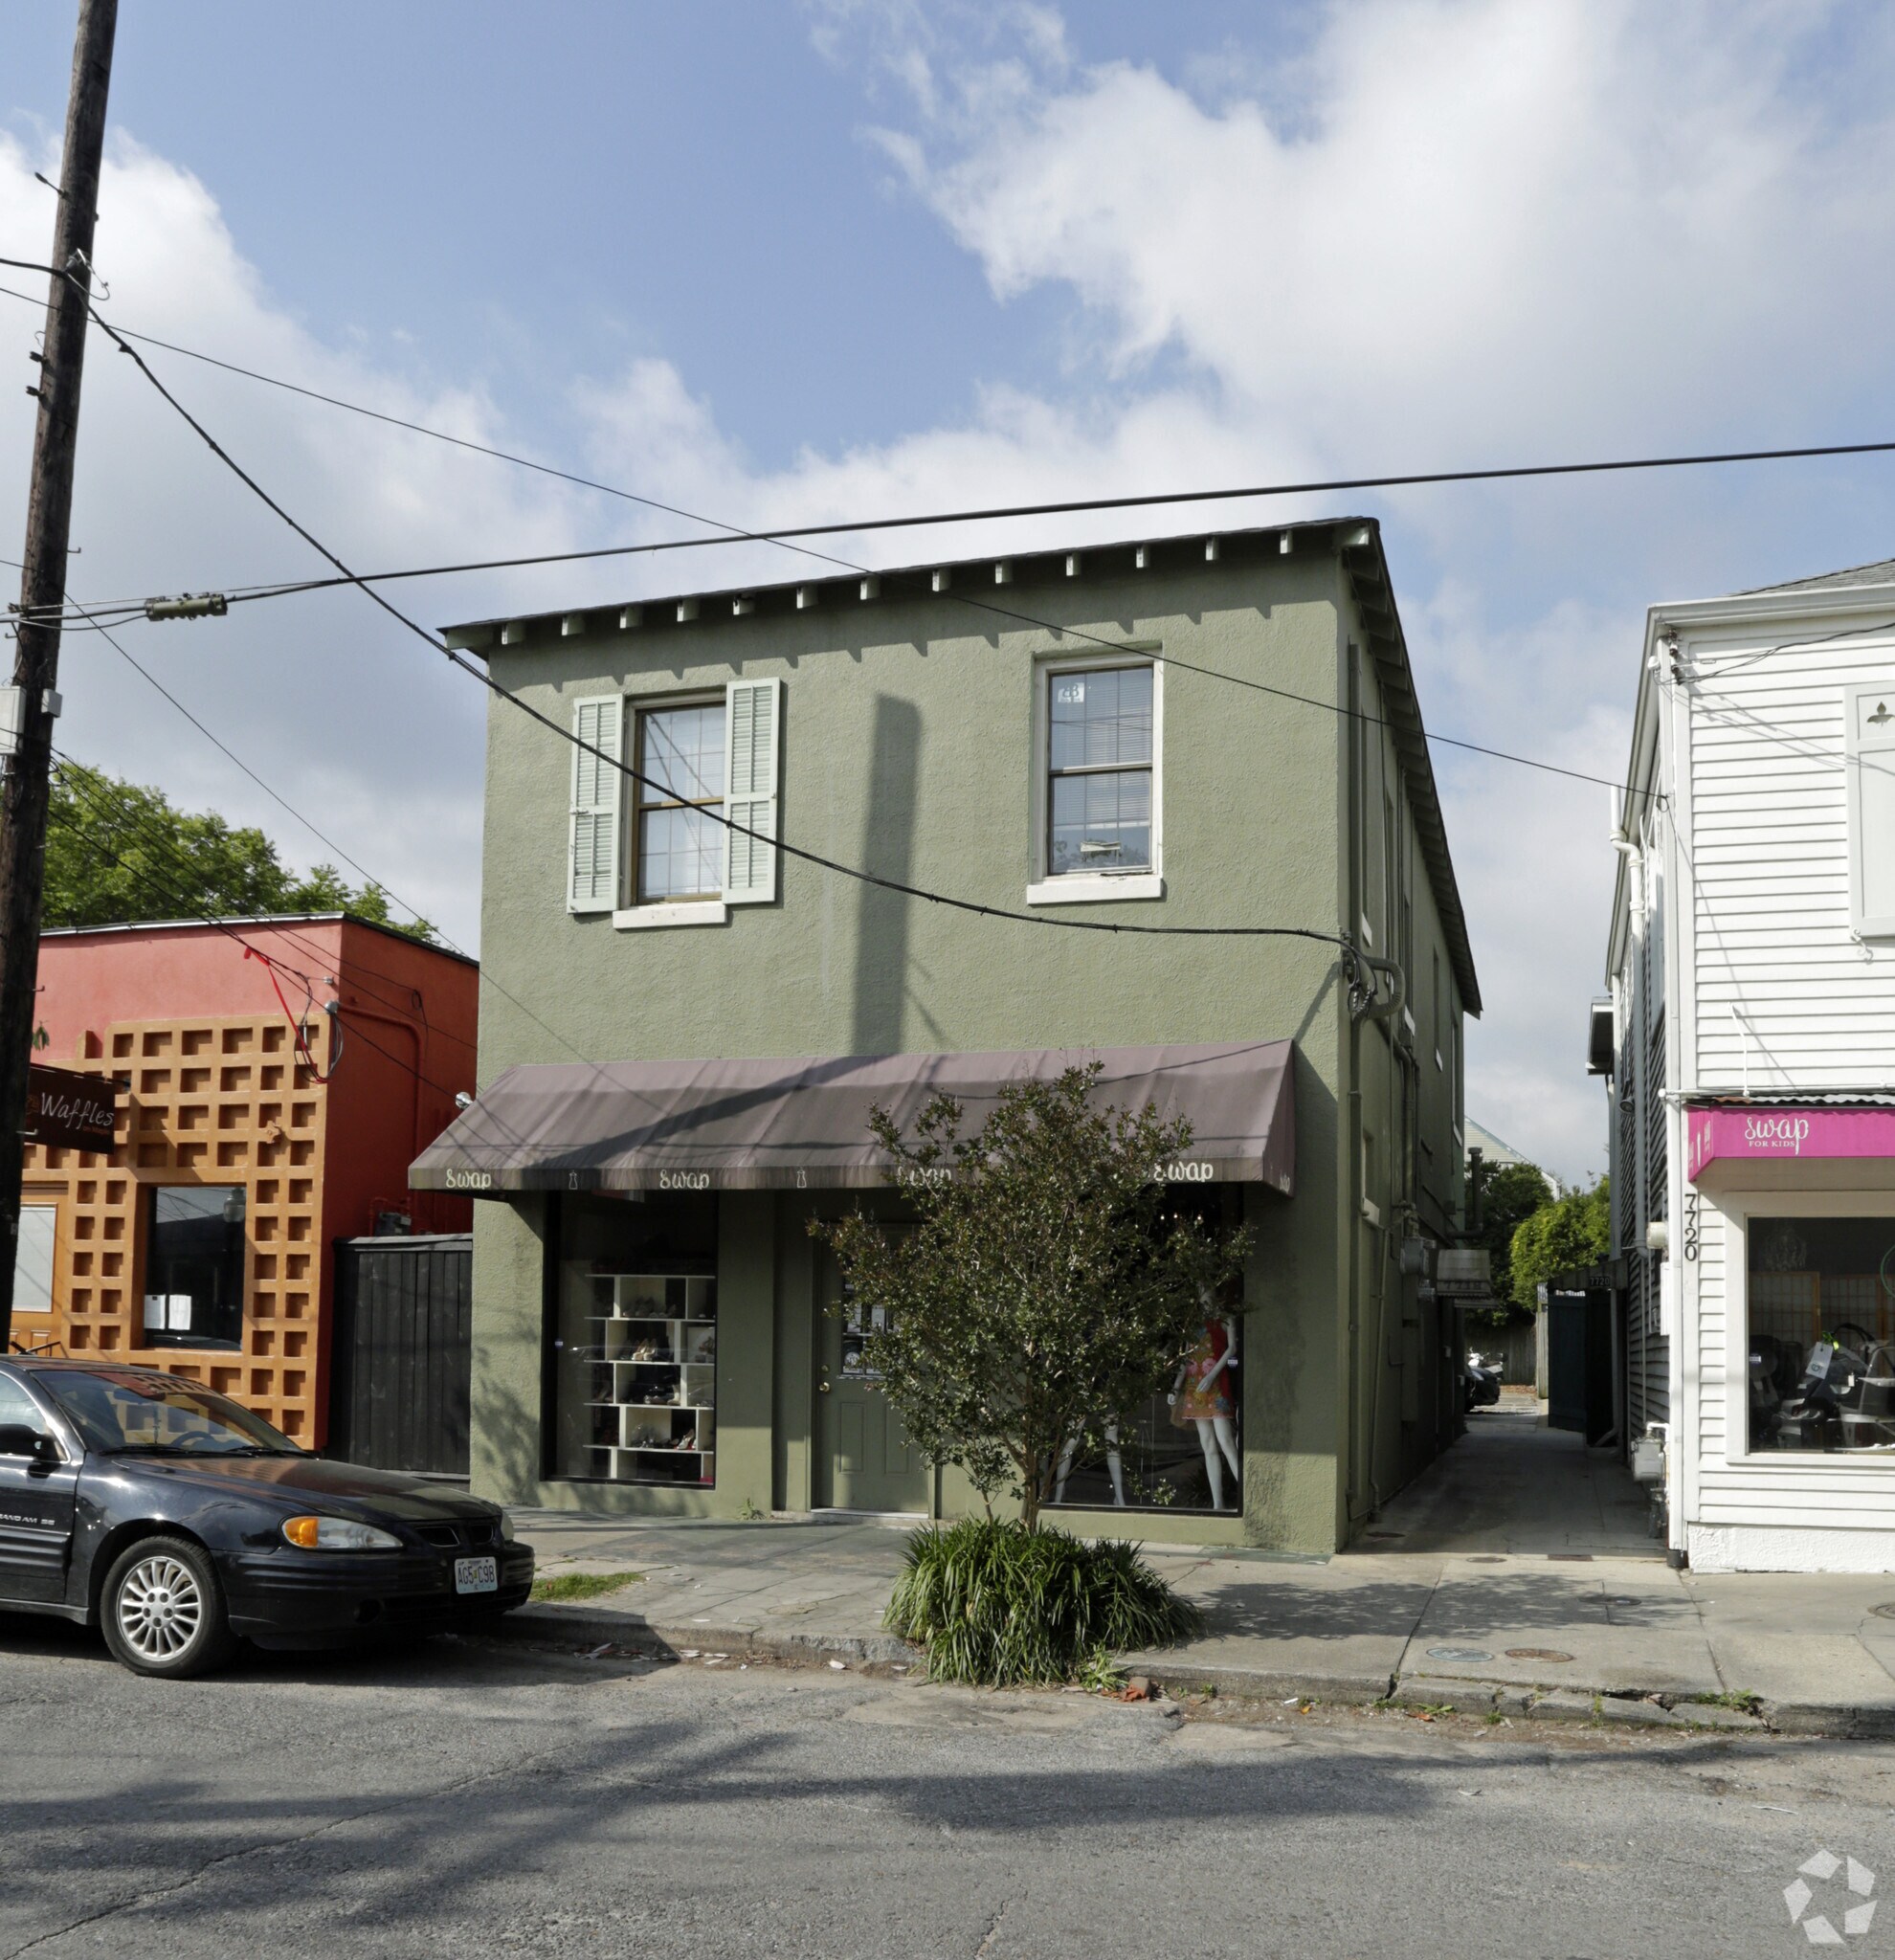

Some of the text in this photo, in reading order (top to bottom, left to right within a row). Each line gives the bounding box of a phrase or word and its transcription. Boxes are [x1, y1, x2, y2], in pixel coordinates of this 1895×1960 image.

[41, 1092, 115, 1130] Waffles
[1684, 1193, 1698, 1261] 7720
[1590, 1277, 1610, 1286] 7720
